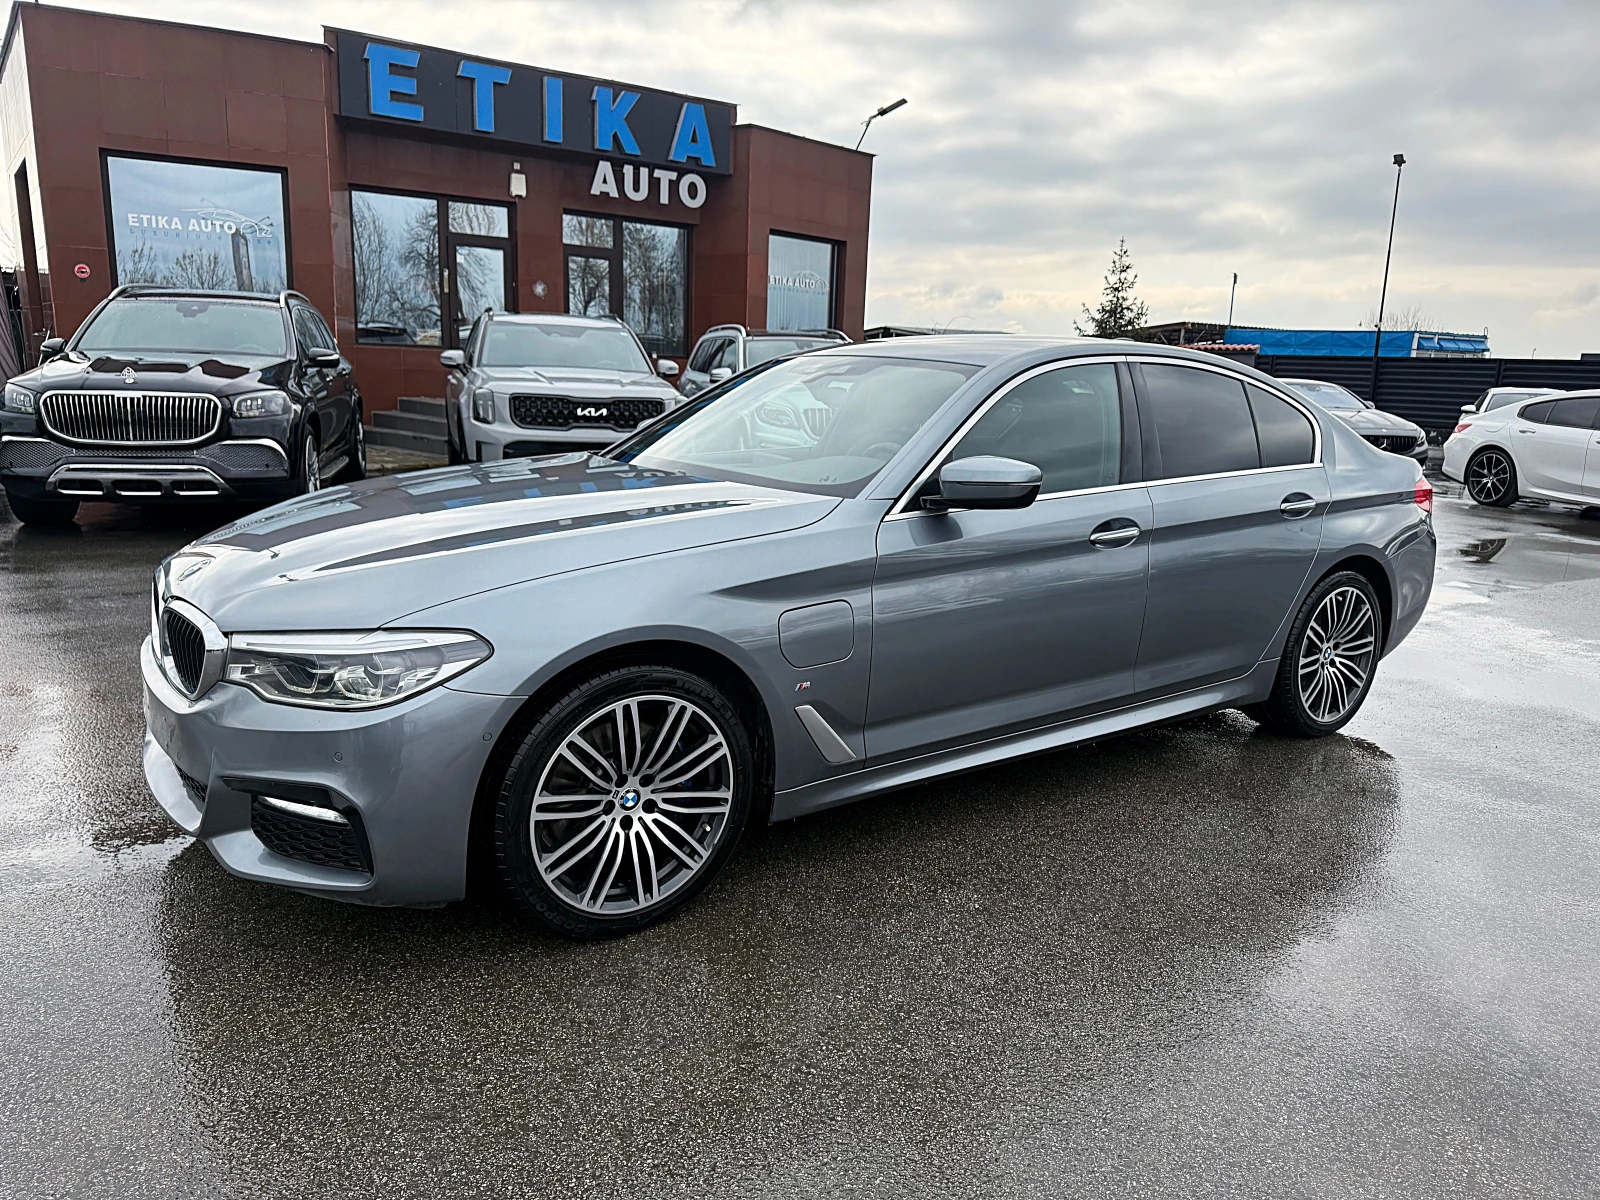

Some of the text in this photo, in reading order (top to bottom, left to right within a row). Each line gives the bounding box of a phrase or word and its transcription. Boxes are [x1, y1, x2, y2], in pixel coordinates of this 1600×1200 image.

[363, 42, 716, 167] ETIKA
[590, 160, 707, 209] AUTO
[127, 213, 237, 235] ETIKA AUTO
[769, 274, 816, 289] ETIKA AUTO
[577, 407, 607, 417] KIA
